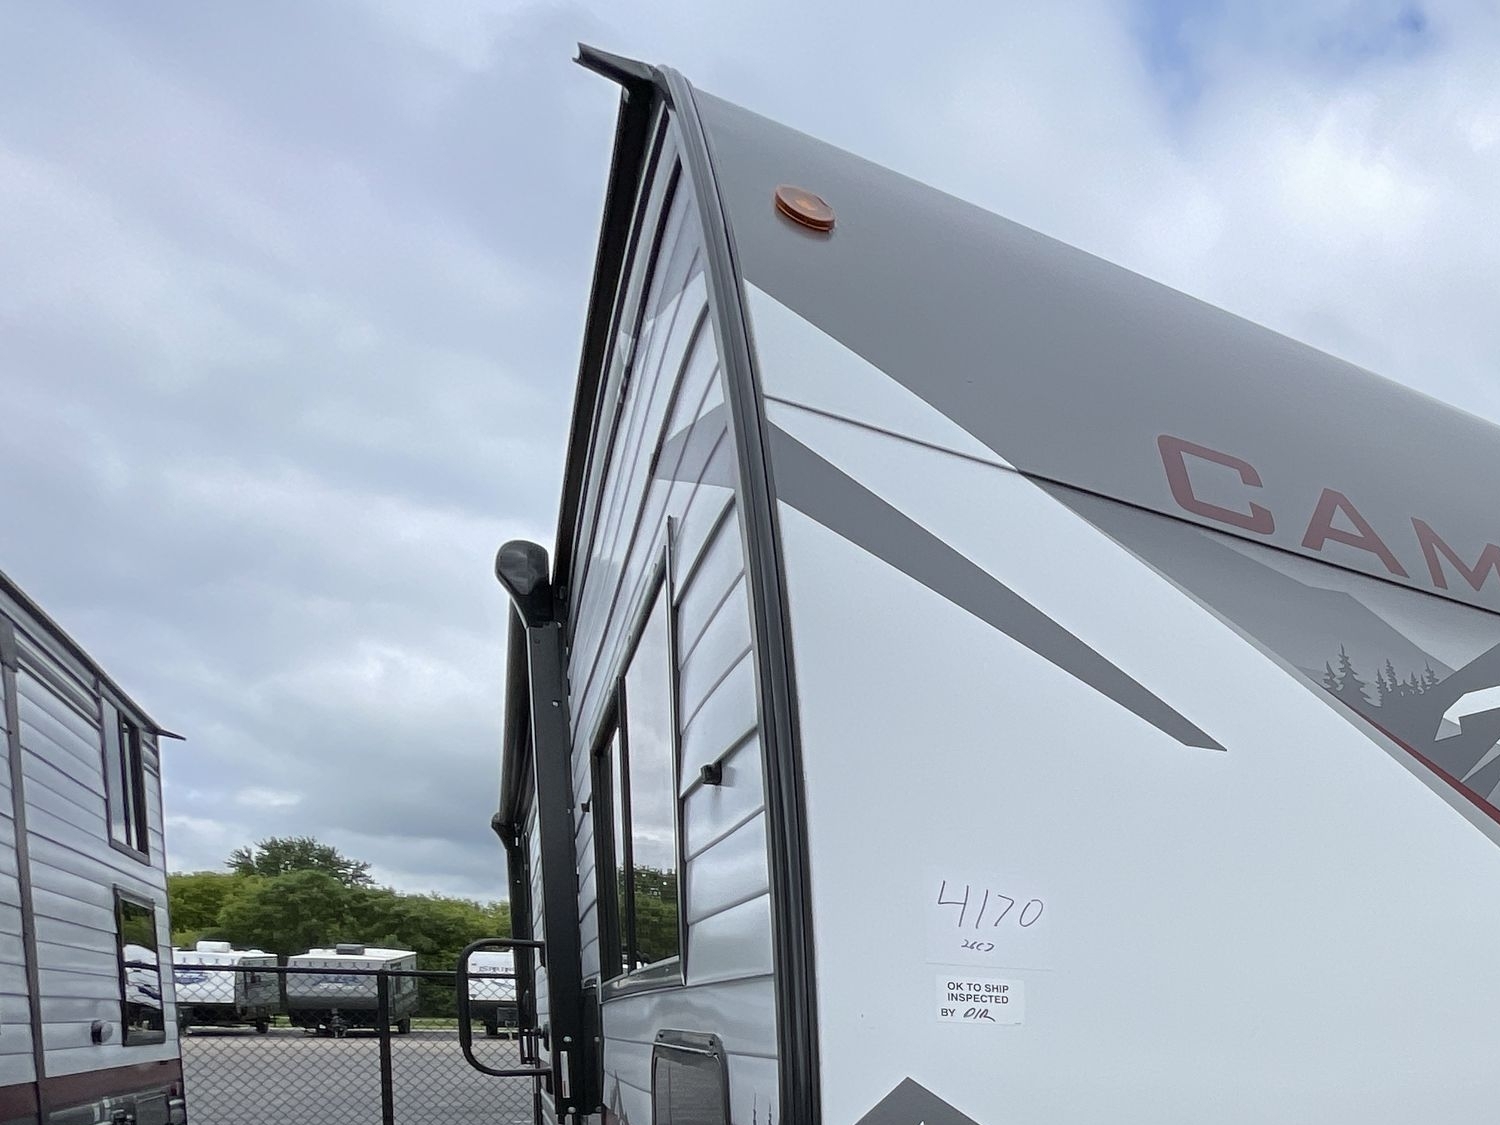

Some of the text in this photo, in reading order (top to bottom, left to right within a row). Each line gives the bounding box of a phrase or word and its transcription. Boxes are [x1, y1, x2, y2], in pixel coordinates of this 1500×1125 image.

[937, 880, 1044, 929] 4170
[947, 981, 1009, 993] OK TO SHIP
[947, 993, 1009, 1004] INSPECTED
[941, 1008, 956, 1017] BY
